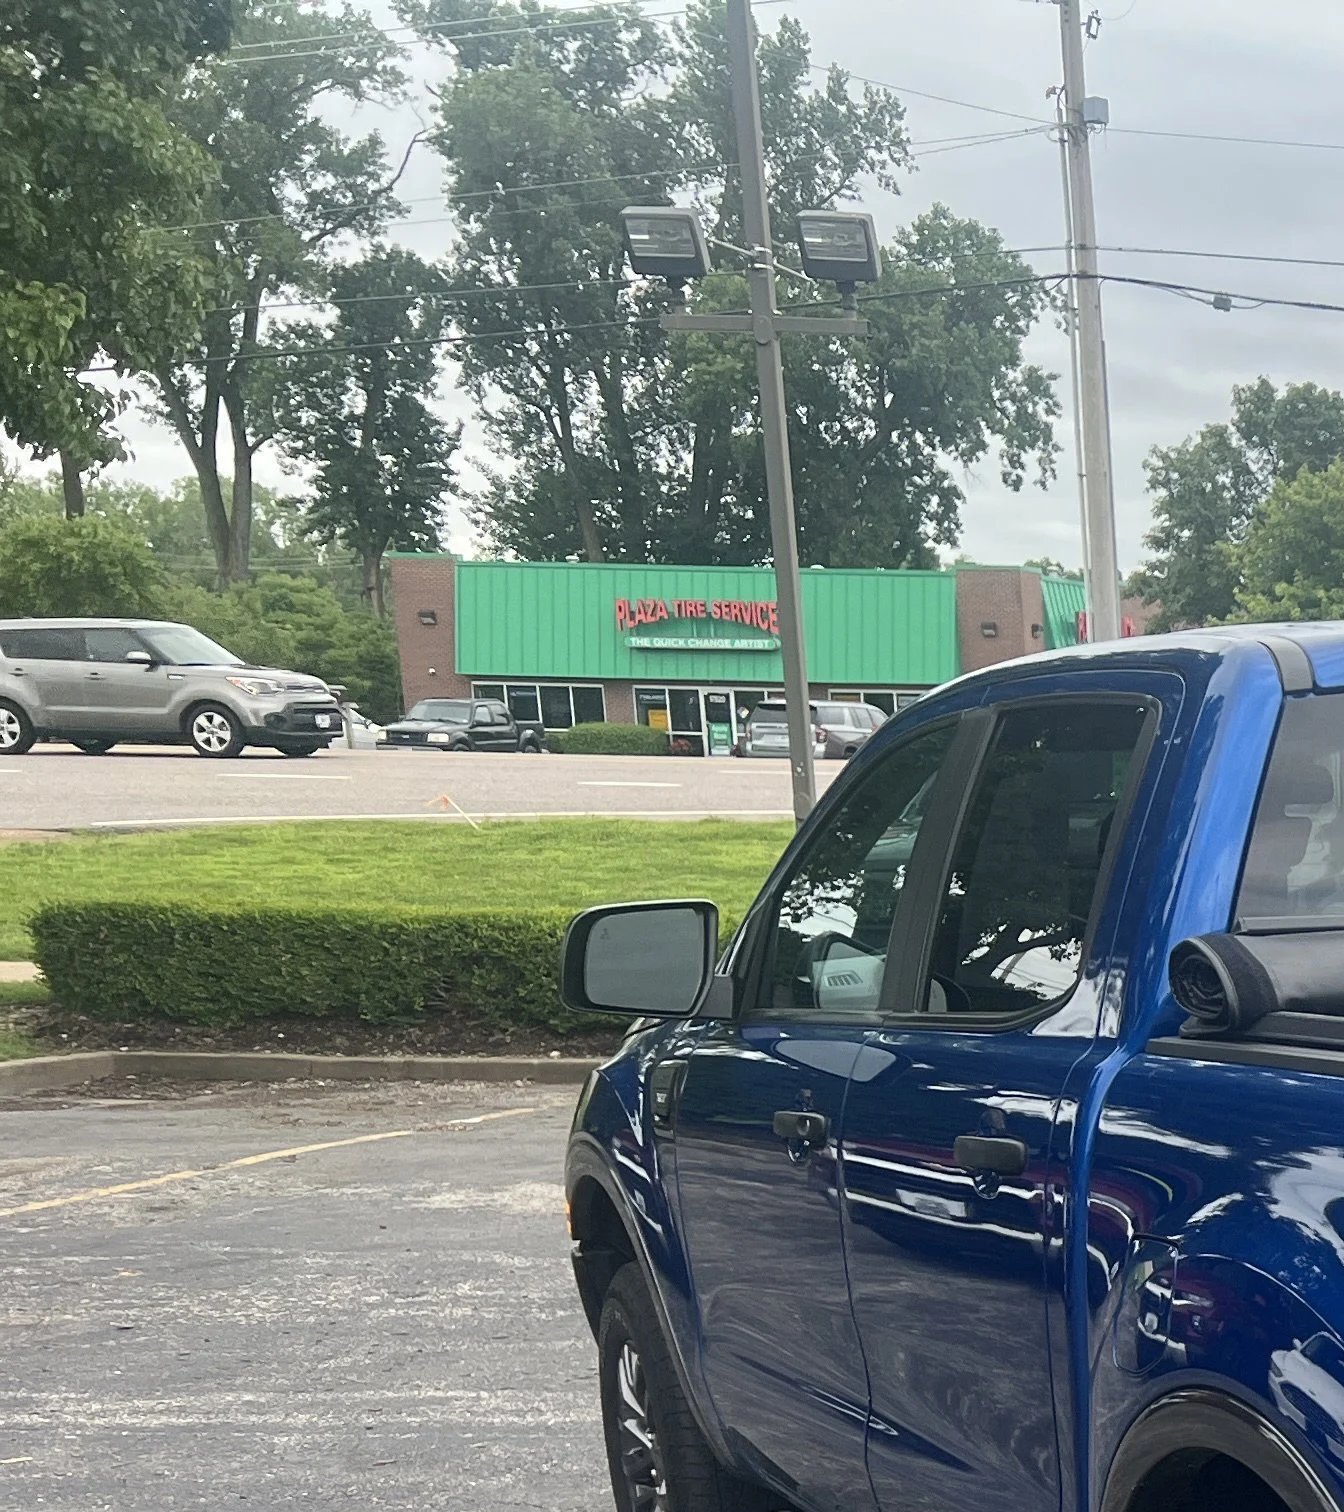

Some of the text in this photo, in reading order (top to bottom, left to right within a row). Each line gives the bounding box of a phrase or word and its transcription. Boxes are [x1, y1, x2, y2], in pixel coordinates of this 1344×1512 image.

[614, 597, 781, 635] PLAZA TIRE SERVICE
[629, 637, 769, 649] THE QUICK CHANGE ARTIST
